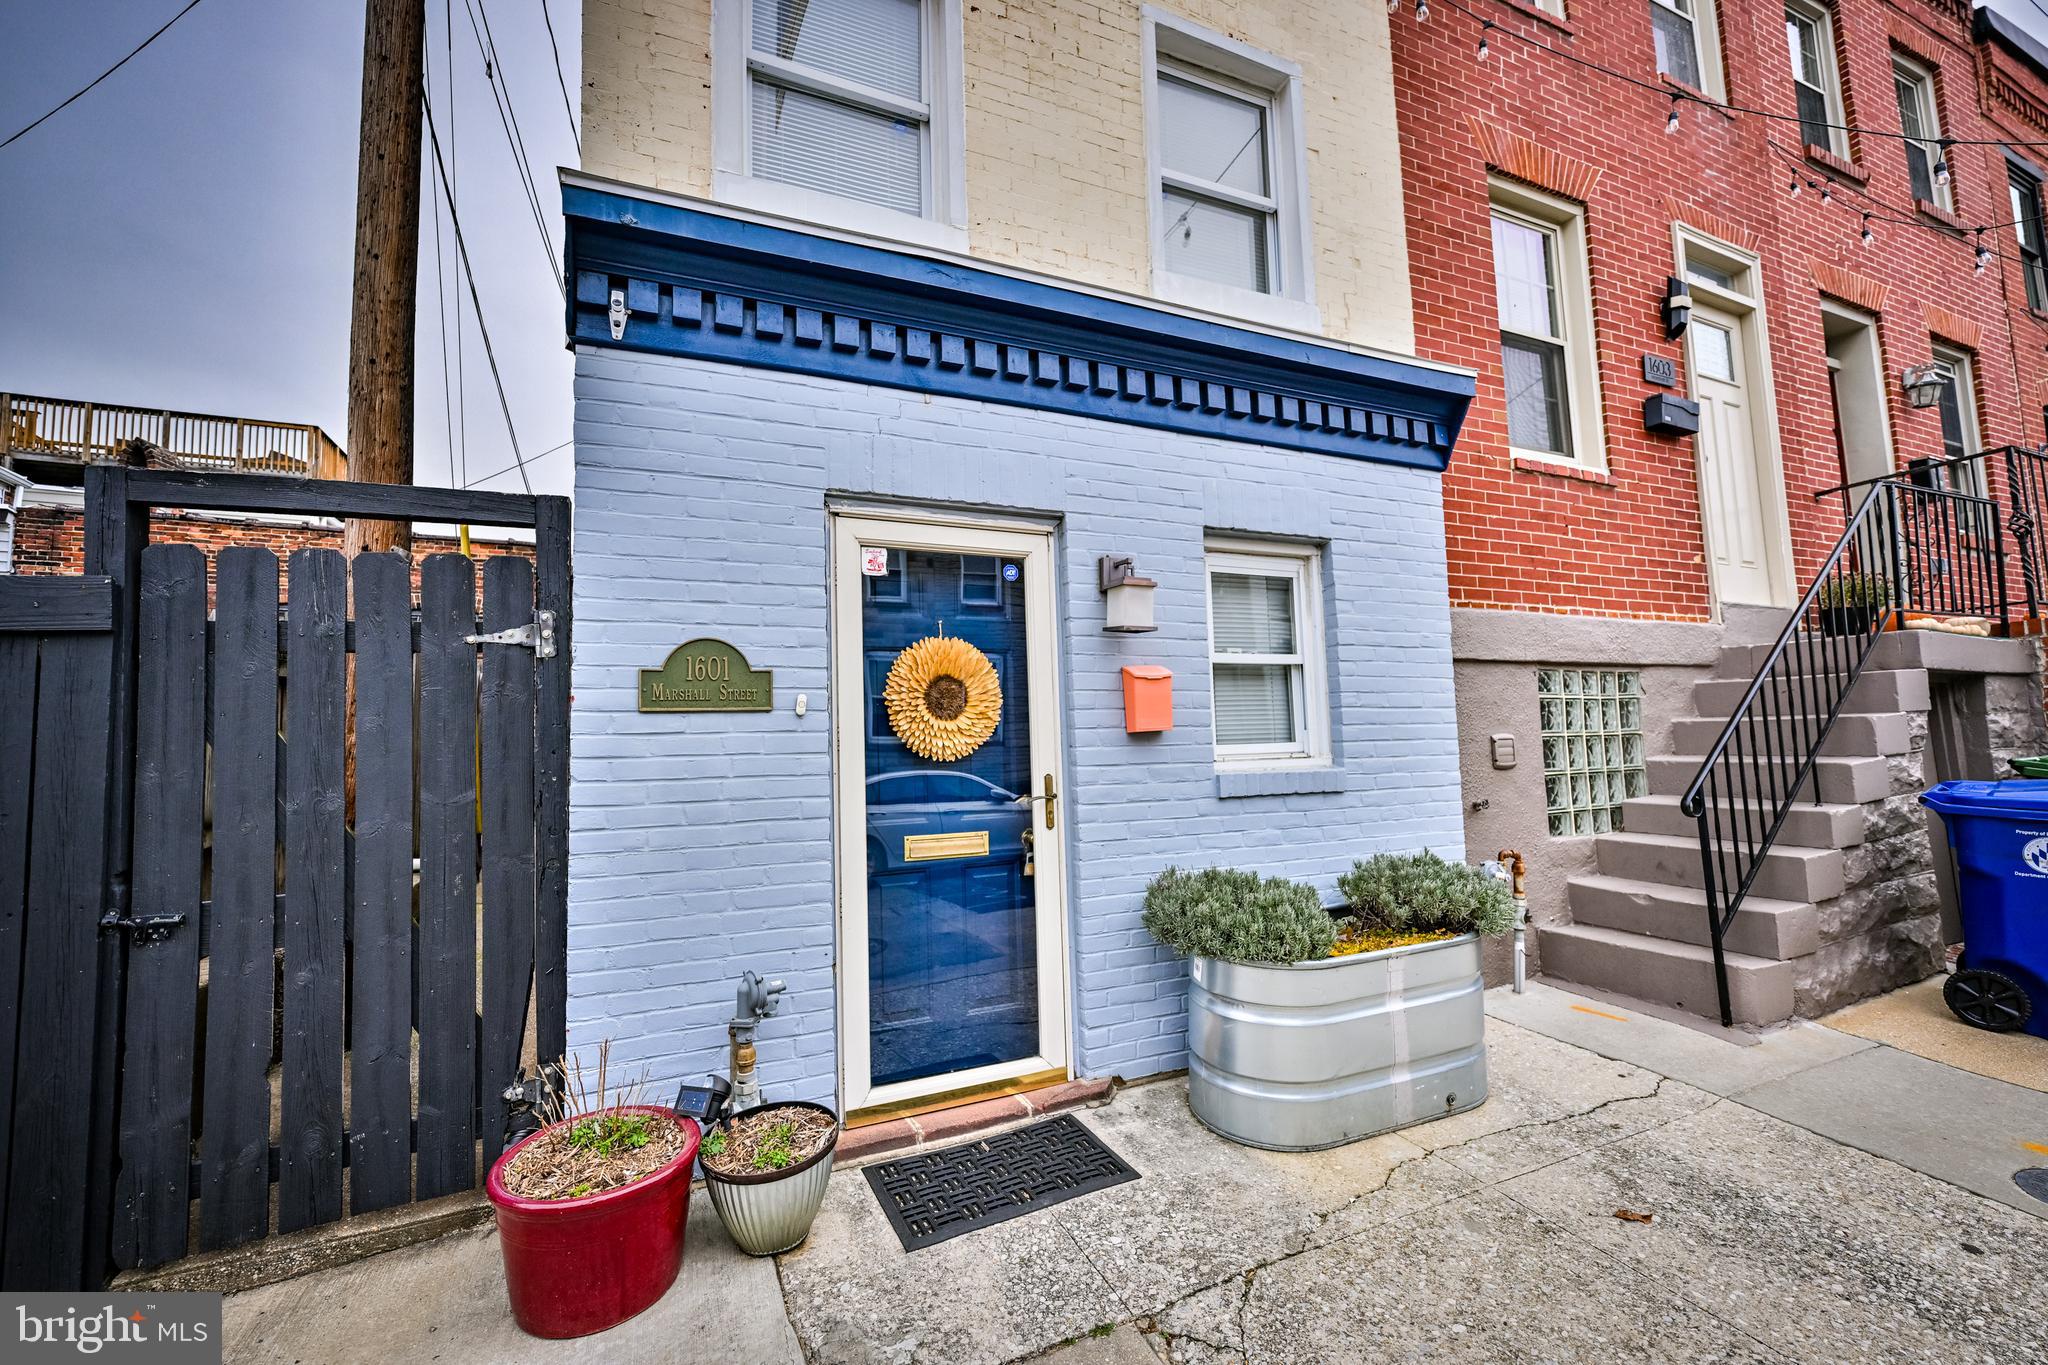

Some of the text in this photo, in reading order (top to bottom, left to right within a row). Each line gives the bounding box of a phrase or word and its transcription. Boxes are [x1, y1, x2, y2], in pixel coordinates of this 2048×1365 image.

[1648, 357, 1671, 376] 1603
[686, 656, 729, 681] 1601
[2014, 871, 2046, 879] Department
